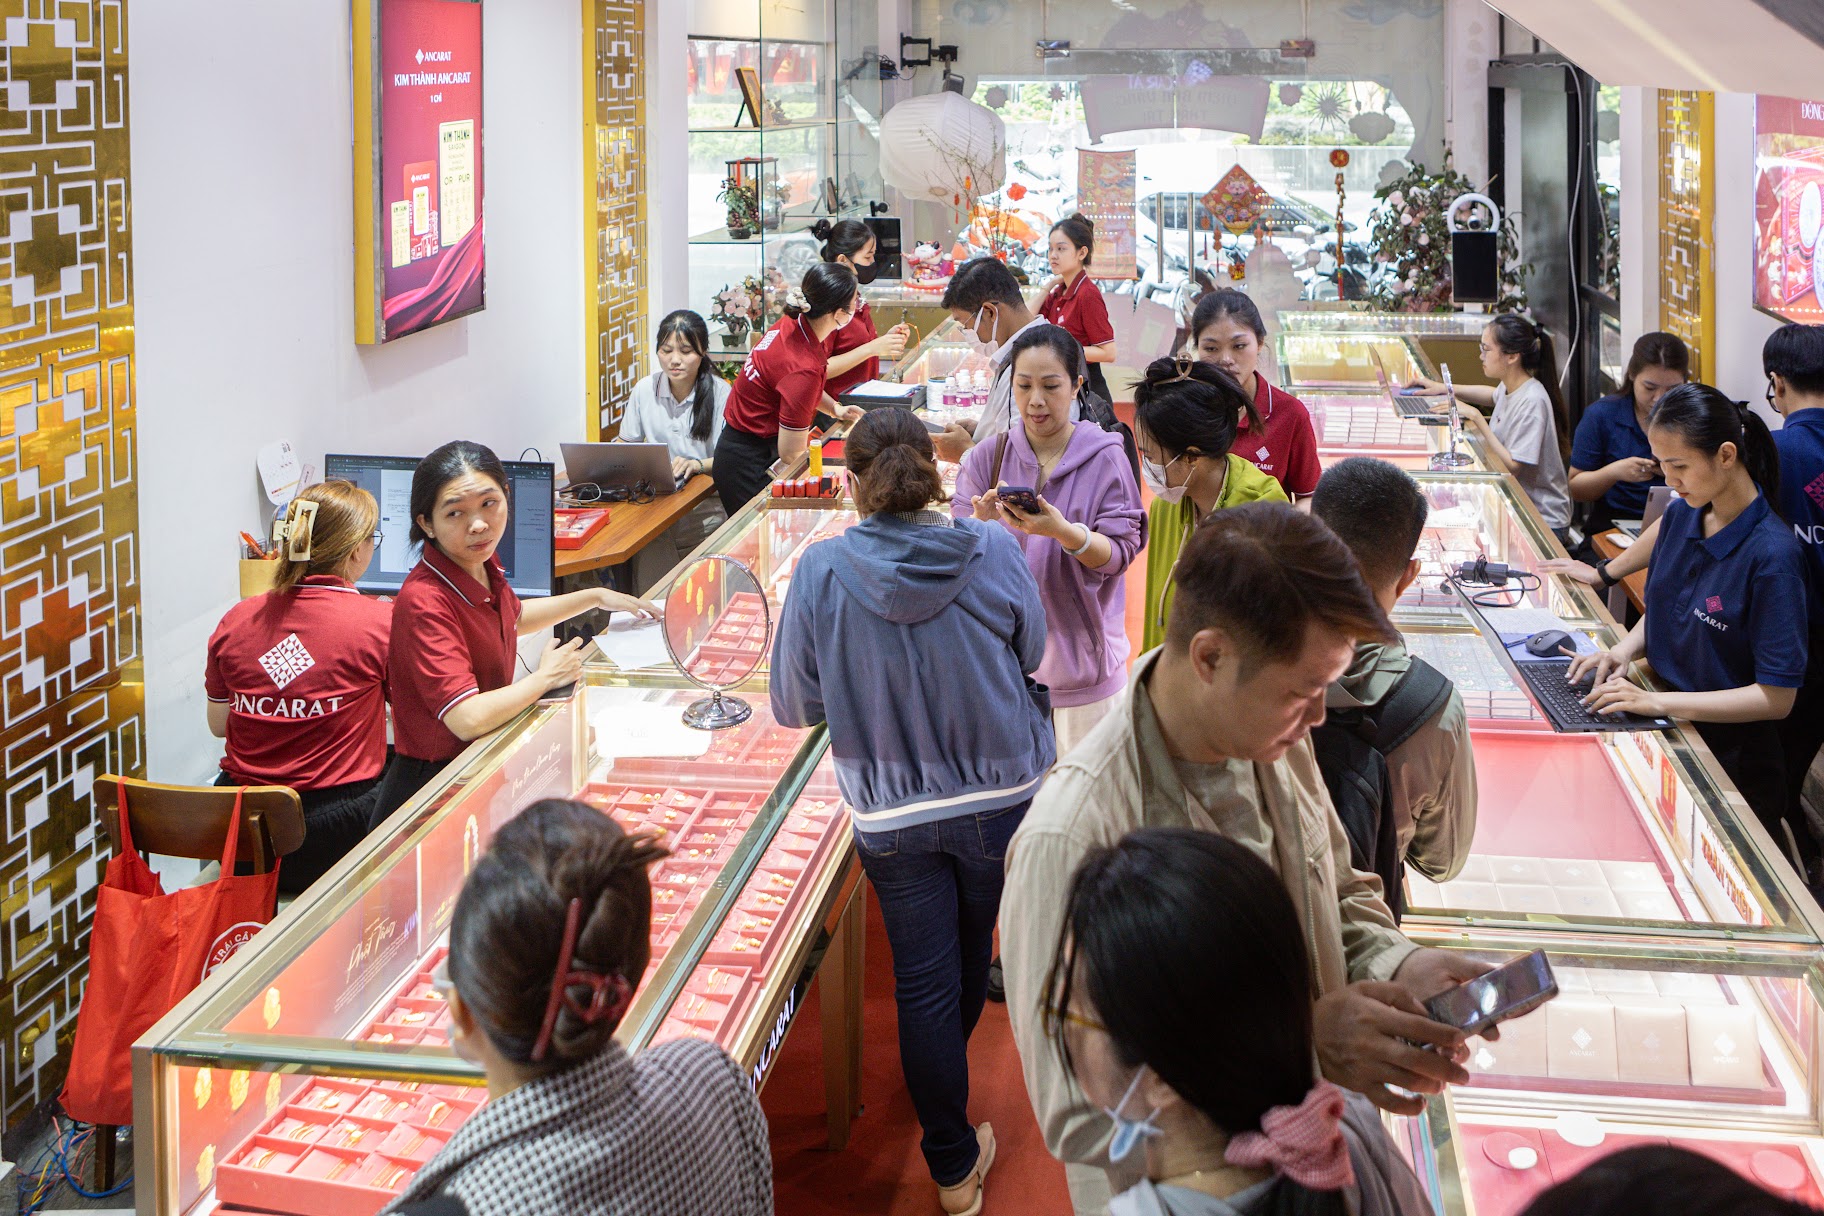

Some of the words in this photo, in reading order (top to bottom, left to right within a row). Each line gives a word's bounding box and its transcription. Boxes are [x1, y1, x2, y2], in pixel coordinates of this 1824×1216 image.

[424, 51, 451, 62] ANCARAT
[394, 73, 409, 87] KIM
[409, 70, 437, 86] THÀNH
[437, 71, 471, 85] ANCARAT
[212, 940, 234, 962] TRÁI
[749, 983, 797, 1095] NCARAT
